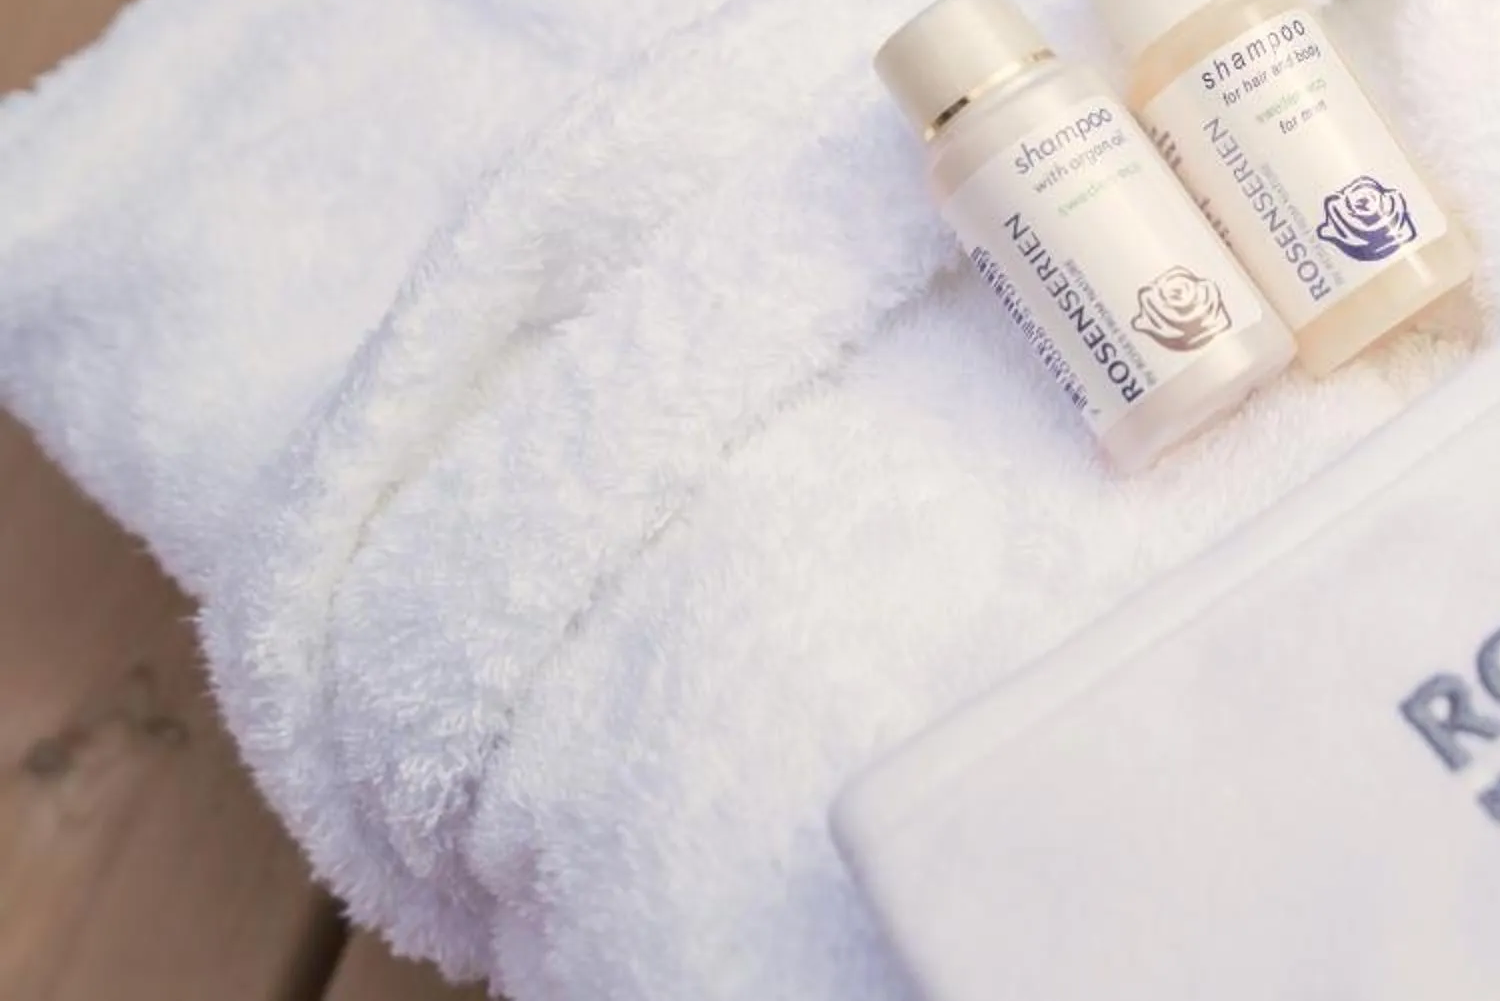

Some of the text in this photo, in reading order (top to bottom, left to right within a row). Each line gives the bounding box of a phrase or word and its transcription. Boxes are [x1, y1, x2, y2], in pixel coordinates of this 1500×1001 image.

[1202, 20, 1305, 89] shampoo
[1222, 88, 1241, 106] for
[1242, 71, 1267, 93] hair
[1014, 108, 1112, 174] shampoo
[1279, 115, 1298, 134] for
[1033, 163, 1068, 193] with
[1204, 118, 1331, 300] ROSENSERIEN
[1004, 212, 1145, 403] ROSENSERIEN
